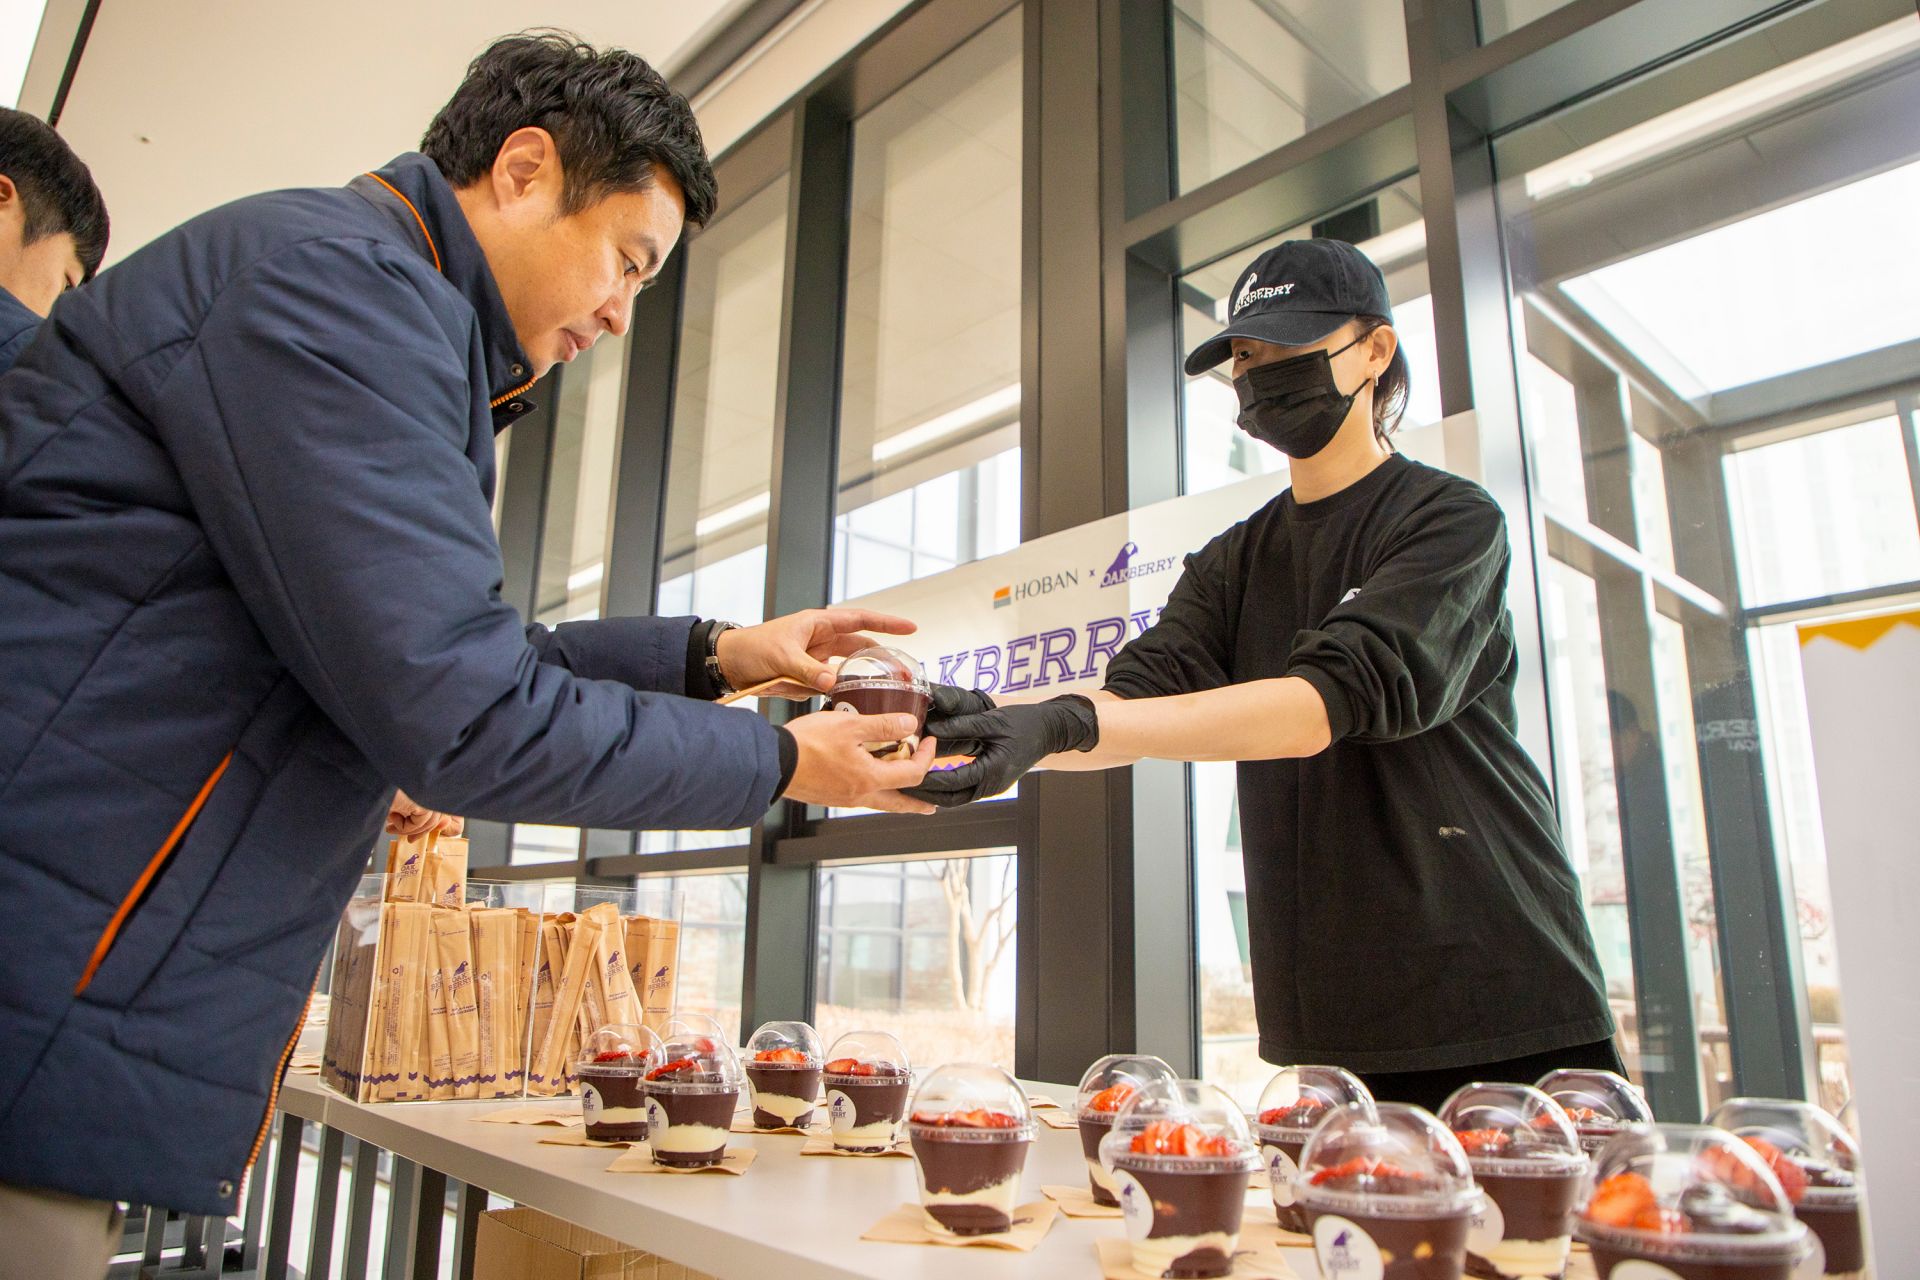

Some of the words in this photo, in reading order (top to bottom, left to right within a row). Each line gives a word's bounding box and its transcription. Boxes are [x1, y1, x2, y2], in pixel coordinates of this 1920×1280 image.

[1015, 567, 1079, 601] HOBAN
[1101, 556, 1177, 587] OAKBERRY
[452, 972, 468, 983] OAK
[651, 976, 666, 984] OAK
